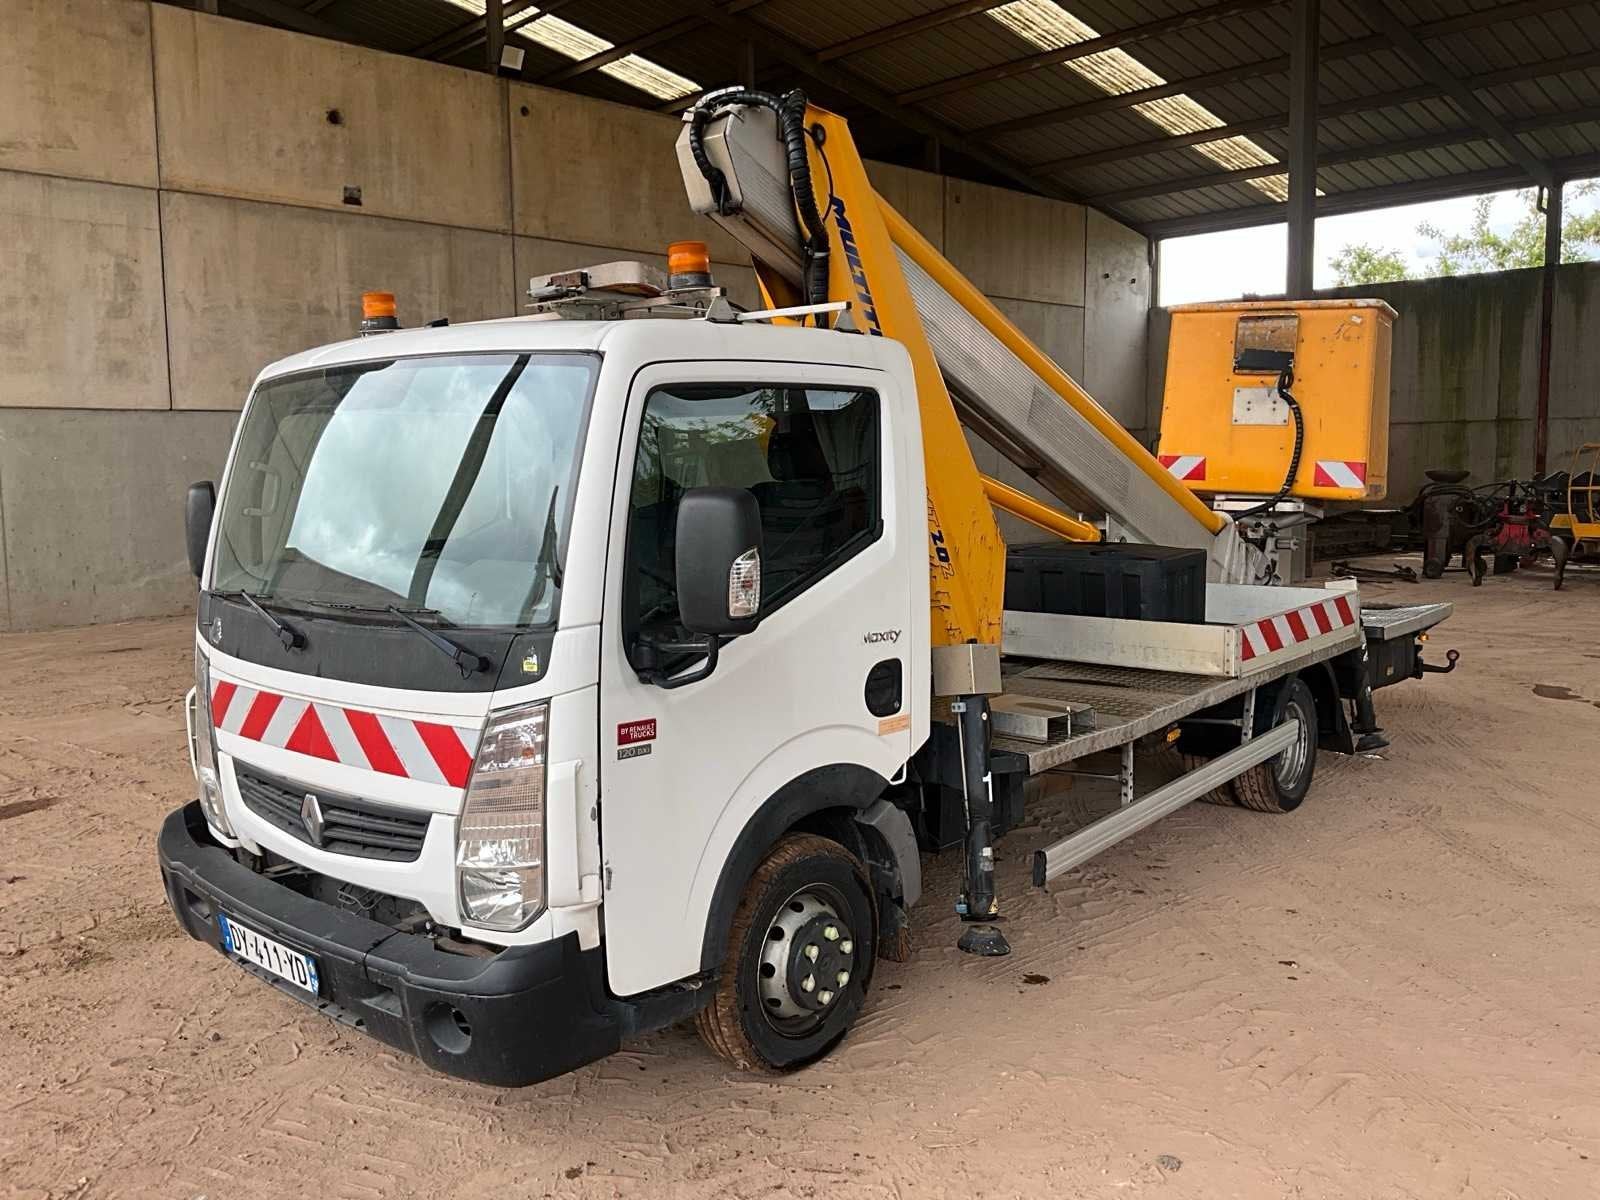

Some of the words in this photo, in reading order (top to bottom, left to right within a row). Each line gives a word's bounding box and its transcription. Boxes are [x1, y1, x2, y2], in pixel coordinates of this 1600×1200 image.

[620, 727, 629, 735] BY
[630, 722, 655, 733] RENAULT
[630, 729, 655, 740] TRUCKS
[229, 923, 308, 986] DY-411-YD
